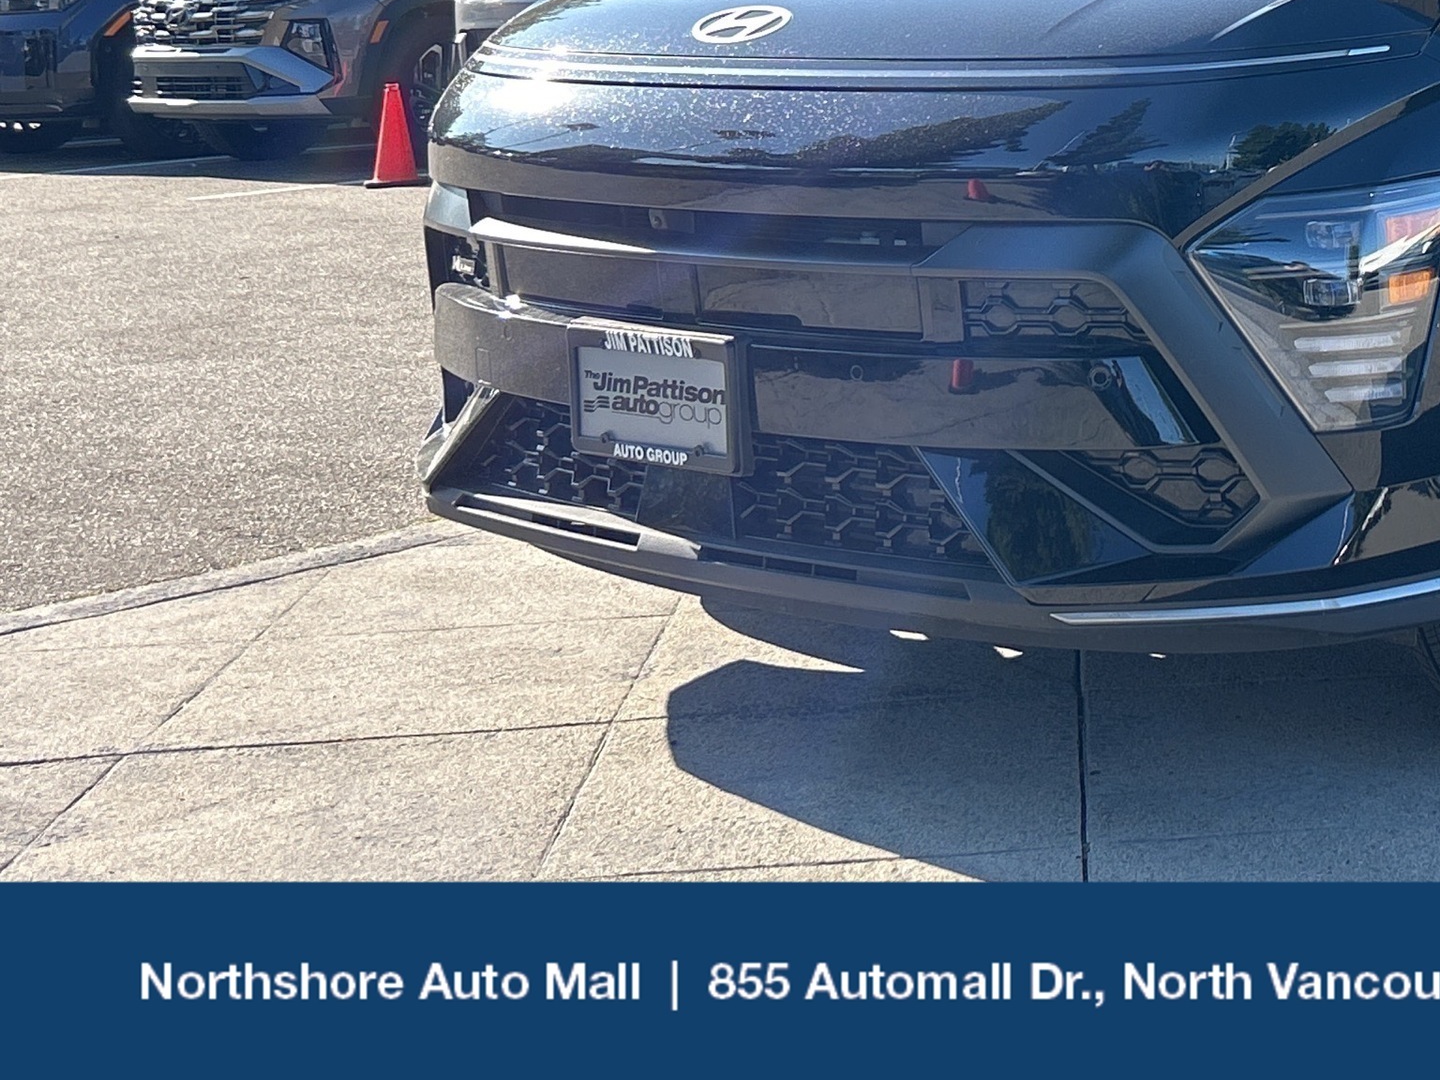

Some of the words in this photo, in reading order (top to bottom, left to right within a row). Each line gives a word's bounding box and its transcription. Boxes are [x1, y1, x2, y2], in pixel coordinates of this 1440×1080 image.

[604, 330, 627, 352] JIM
[628, 332, 694, 358] PATTISON
[584, 370, 600, 380] The
[613, 442, 645, 461] AUTO
[646, 448, 688, 466] GROUP
